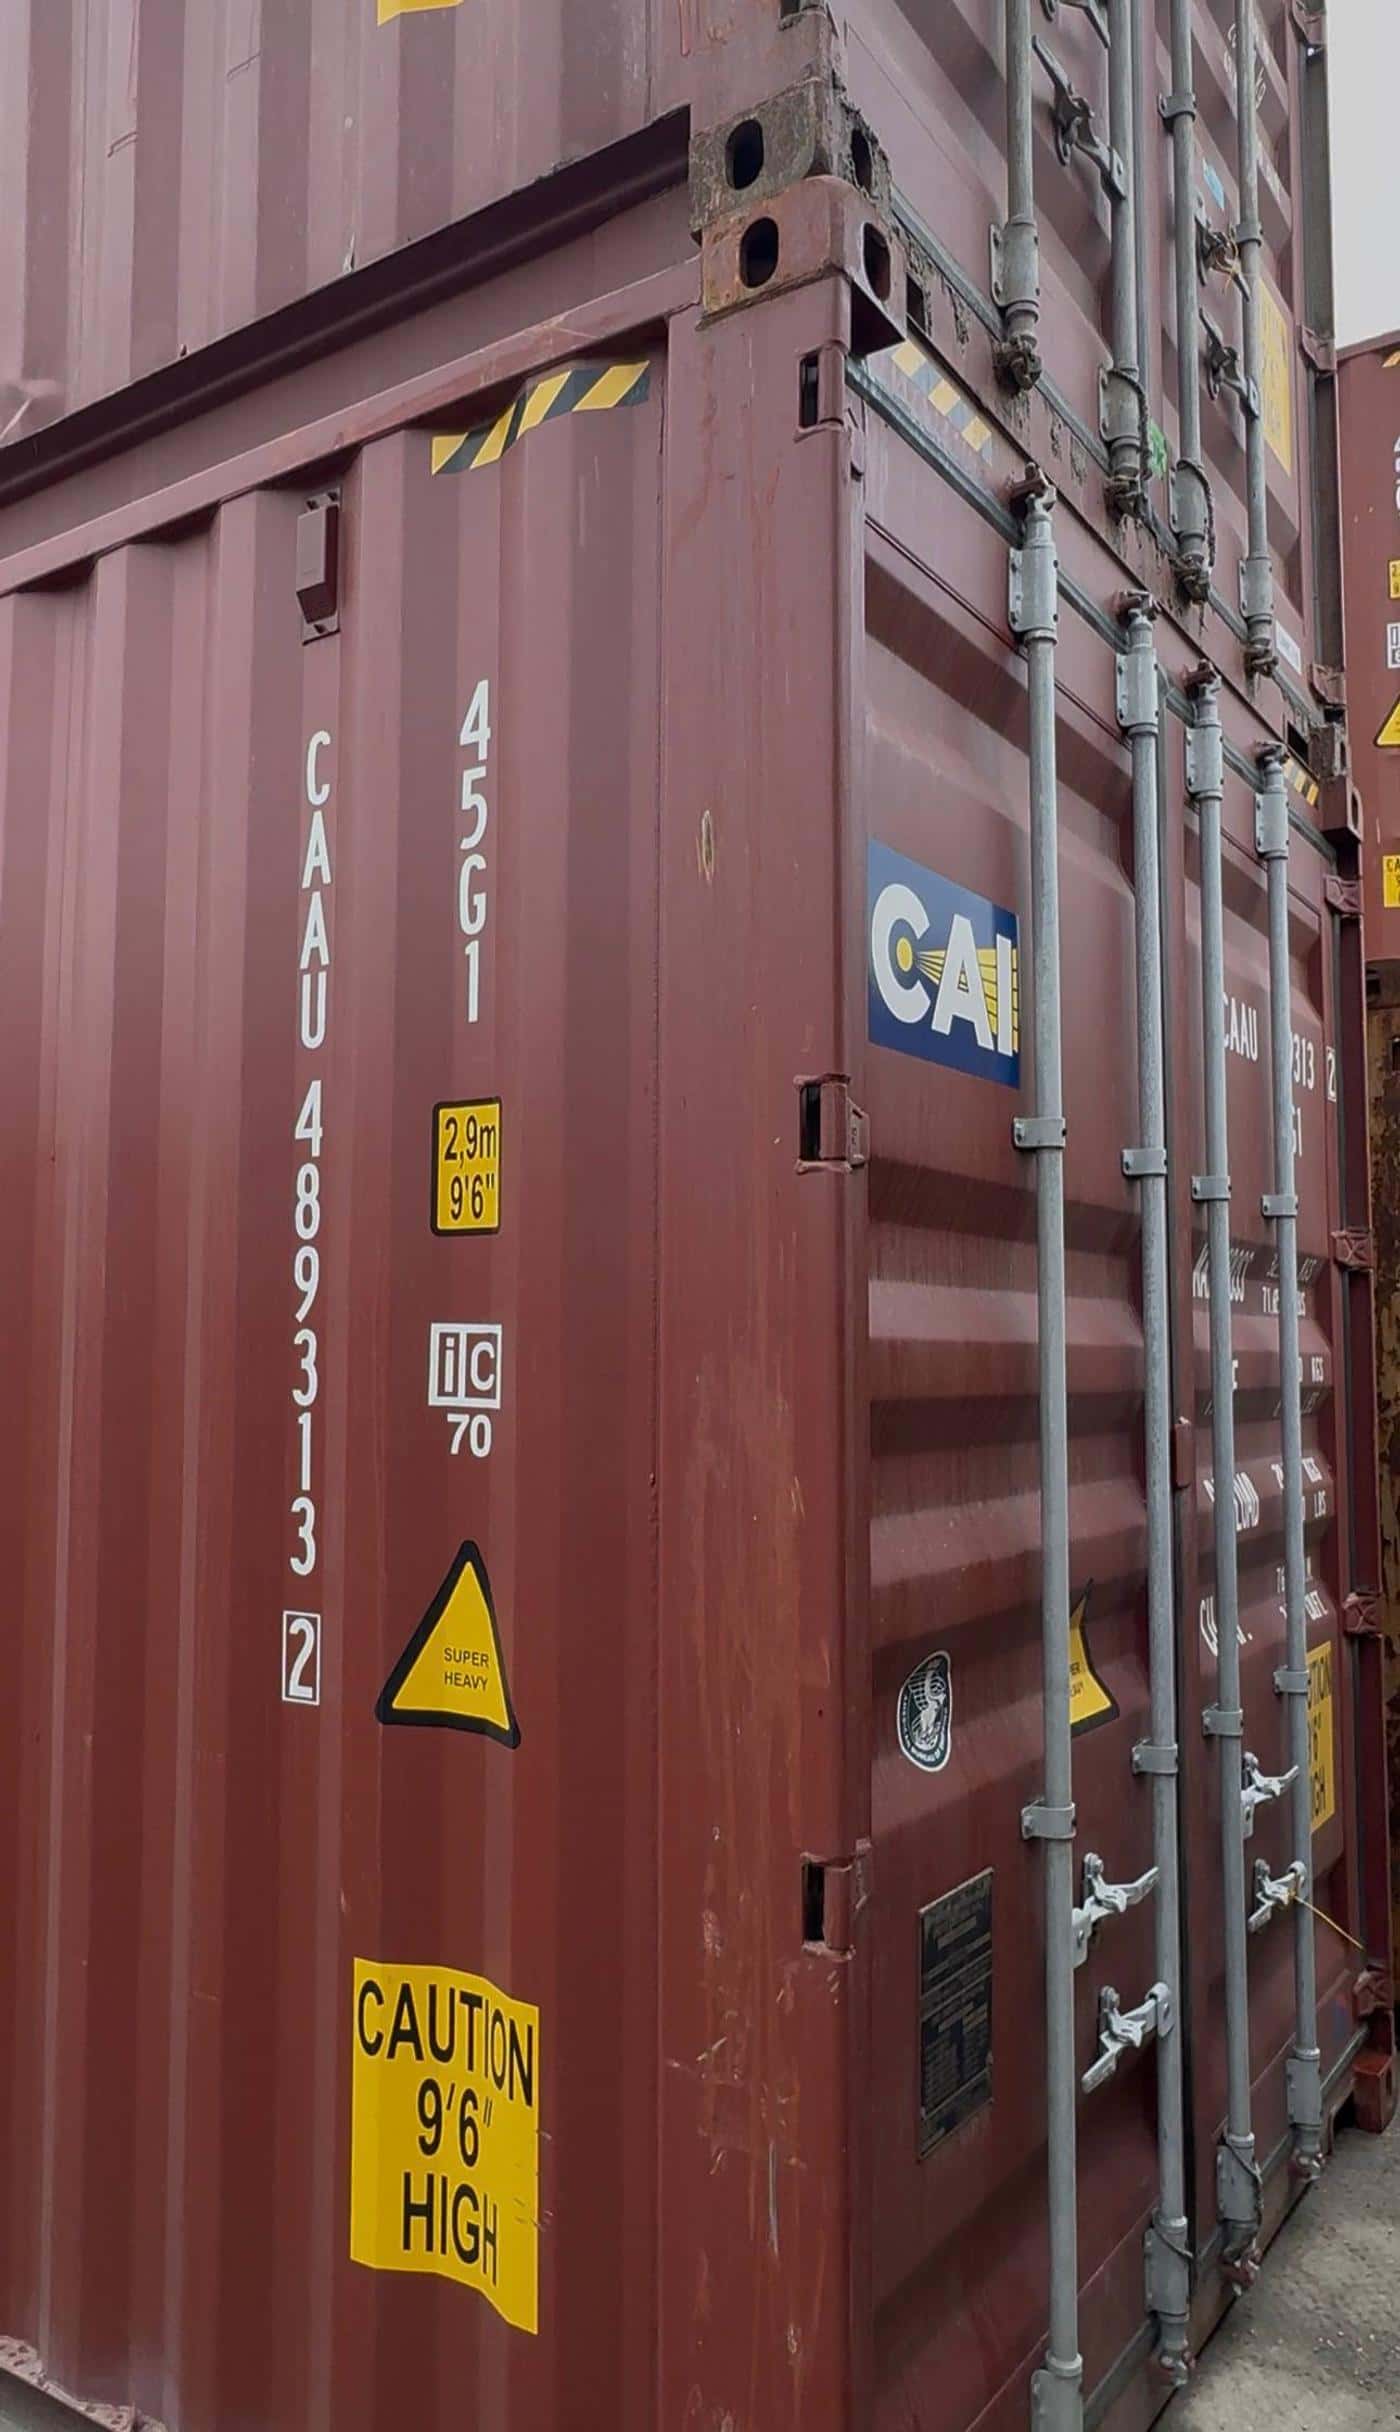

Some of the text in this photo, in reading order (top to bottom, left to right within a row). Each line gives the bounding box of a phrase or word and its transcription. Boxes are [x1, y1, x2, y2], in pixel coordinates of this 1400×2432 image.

[459, 679, 491, 1022] 45G1
[871, 883, 1013, 1057] CAI
[444, 1115, 497, 1168] 2,9m
[288, 730, 331, 1699] CAAU 489313 2
[450, 1173, 495, 1221] 9'6"
[447, 1414, 492, 1457] 70
[444, 1647, 490, 1668] SUPER
[444, 1672, 489, 1691] HEAVY
[357, 1980, 533, 2106] CAUTION
[418, 2078, 492, 2168] 9'6"
[402, 2171, 498, 2287] HIGH
